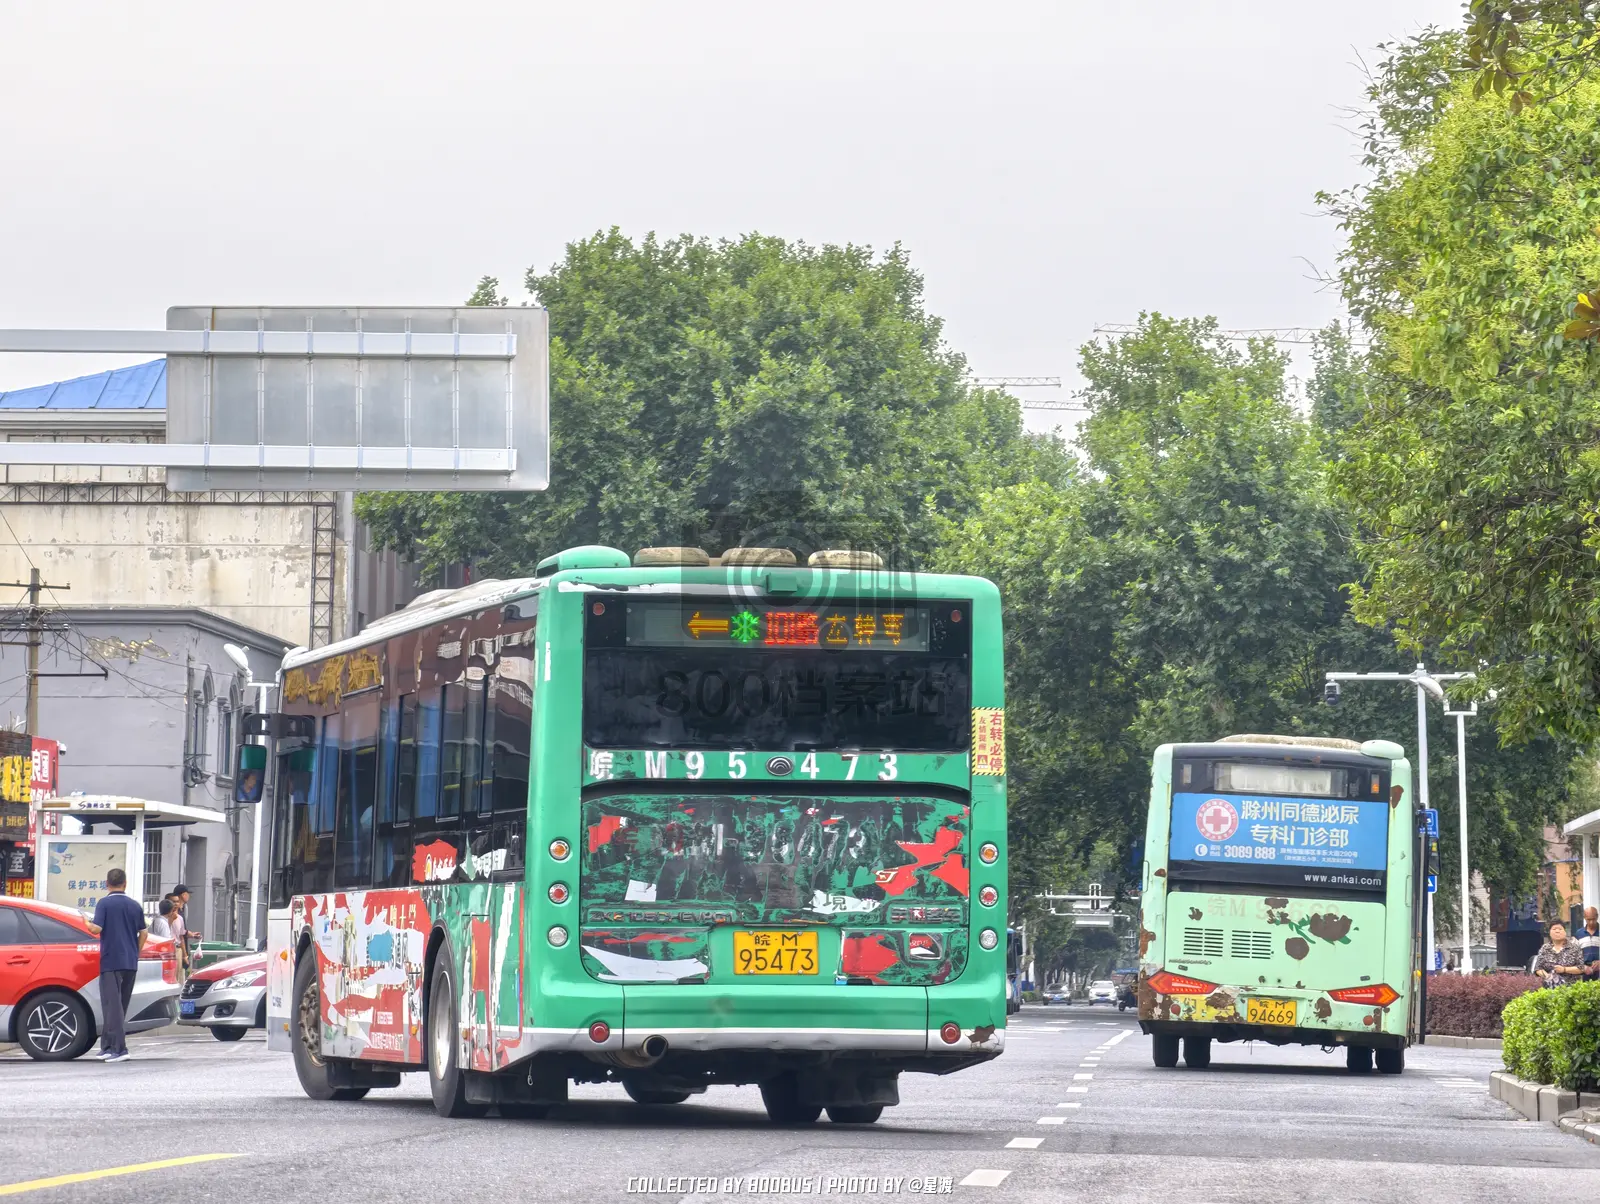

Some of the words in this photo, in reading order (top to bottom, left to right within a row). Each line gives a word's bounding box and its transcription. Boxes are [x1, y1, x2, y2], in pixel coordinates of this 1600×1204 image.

[989, 712, 1003, 771] 右转必停
[1241, 800, 1359, 825] 滁州同德泌尿
[1250, 824, 1349, 848] 专科门诊部
[1224, 845, 1252, 858] 3089
[1254, 846, 1276, 859] 888
[1304, 874, 1382, 886] www.ankai.com
[739, 948, 814, 971] 95473
[1249, 1008, 1294, 1023] 94669
